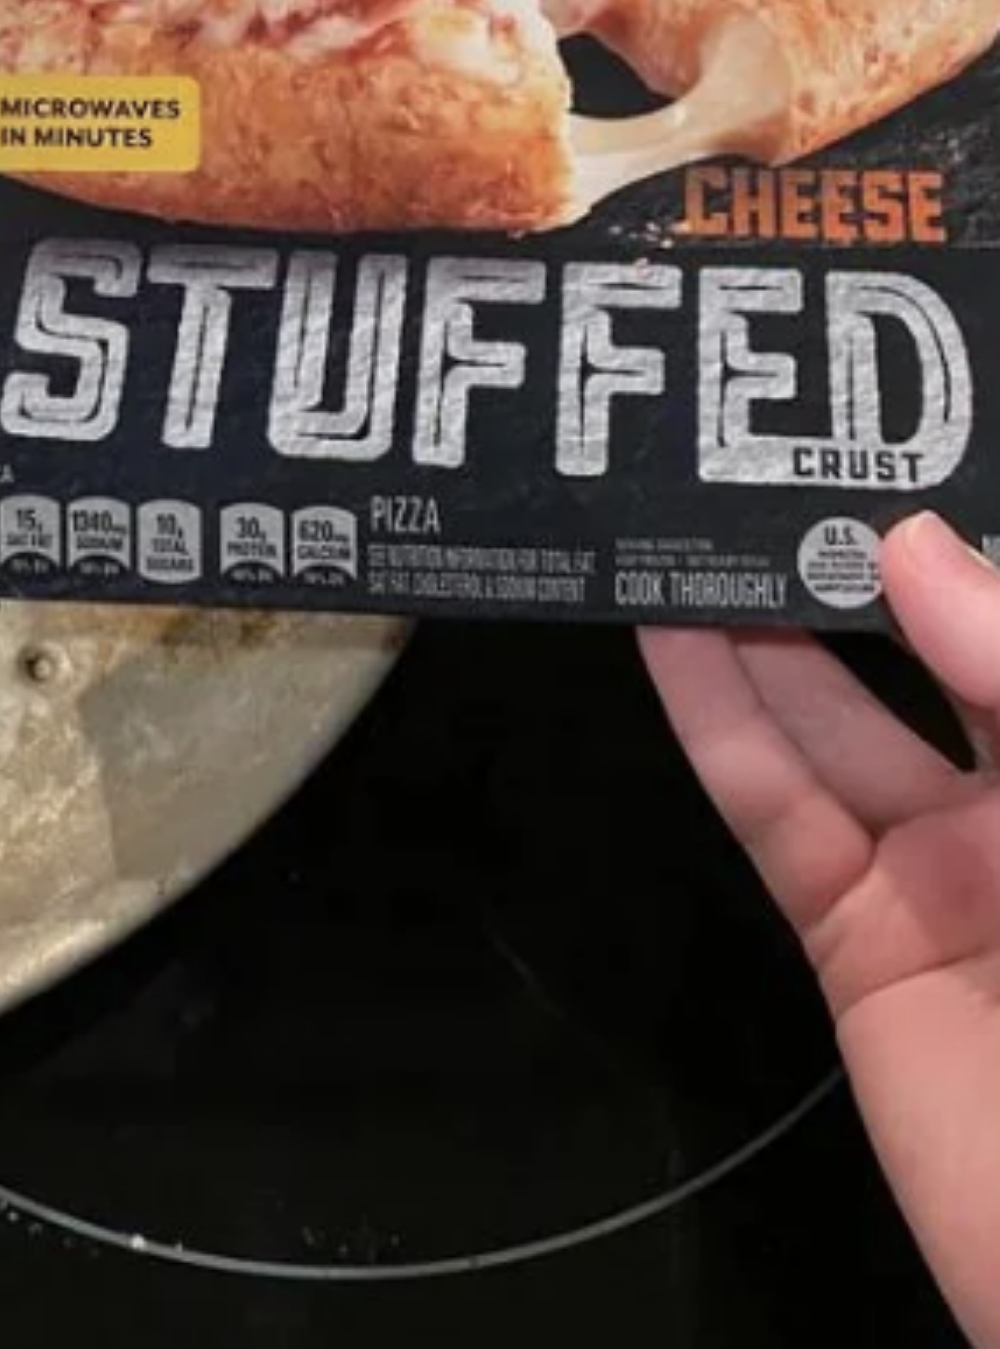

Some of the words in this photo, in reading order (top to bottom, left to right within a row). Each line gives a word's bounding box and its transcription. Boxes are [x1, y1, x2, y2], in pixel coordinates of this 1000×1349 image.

[0, 97, 180, 119] MICROWAVES
[1, 127, 26, 147] IN
[34, 127, 153, 147] MINUTES
[681, 168, 947, 243] CHEESE
[0, 237, 973, 490] STUFFED
[792, 449, 925, 484] CRUST
[369, 495, 441, 533] PIZZA
[824, 526, 858, 546] U.S.
[615, 570, 666, 606] COOK
[668, 571, 788, 609] THOROUGHLY
